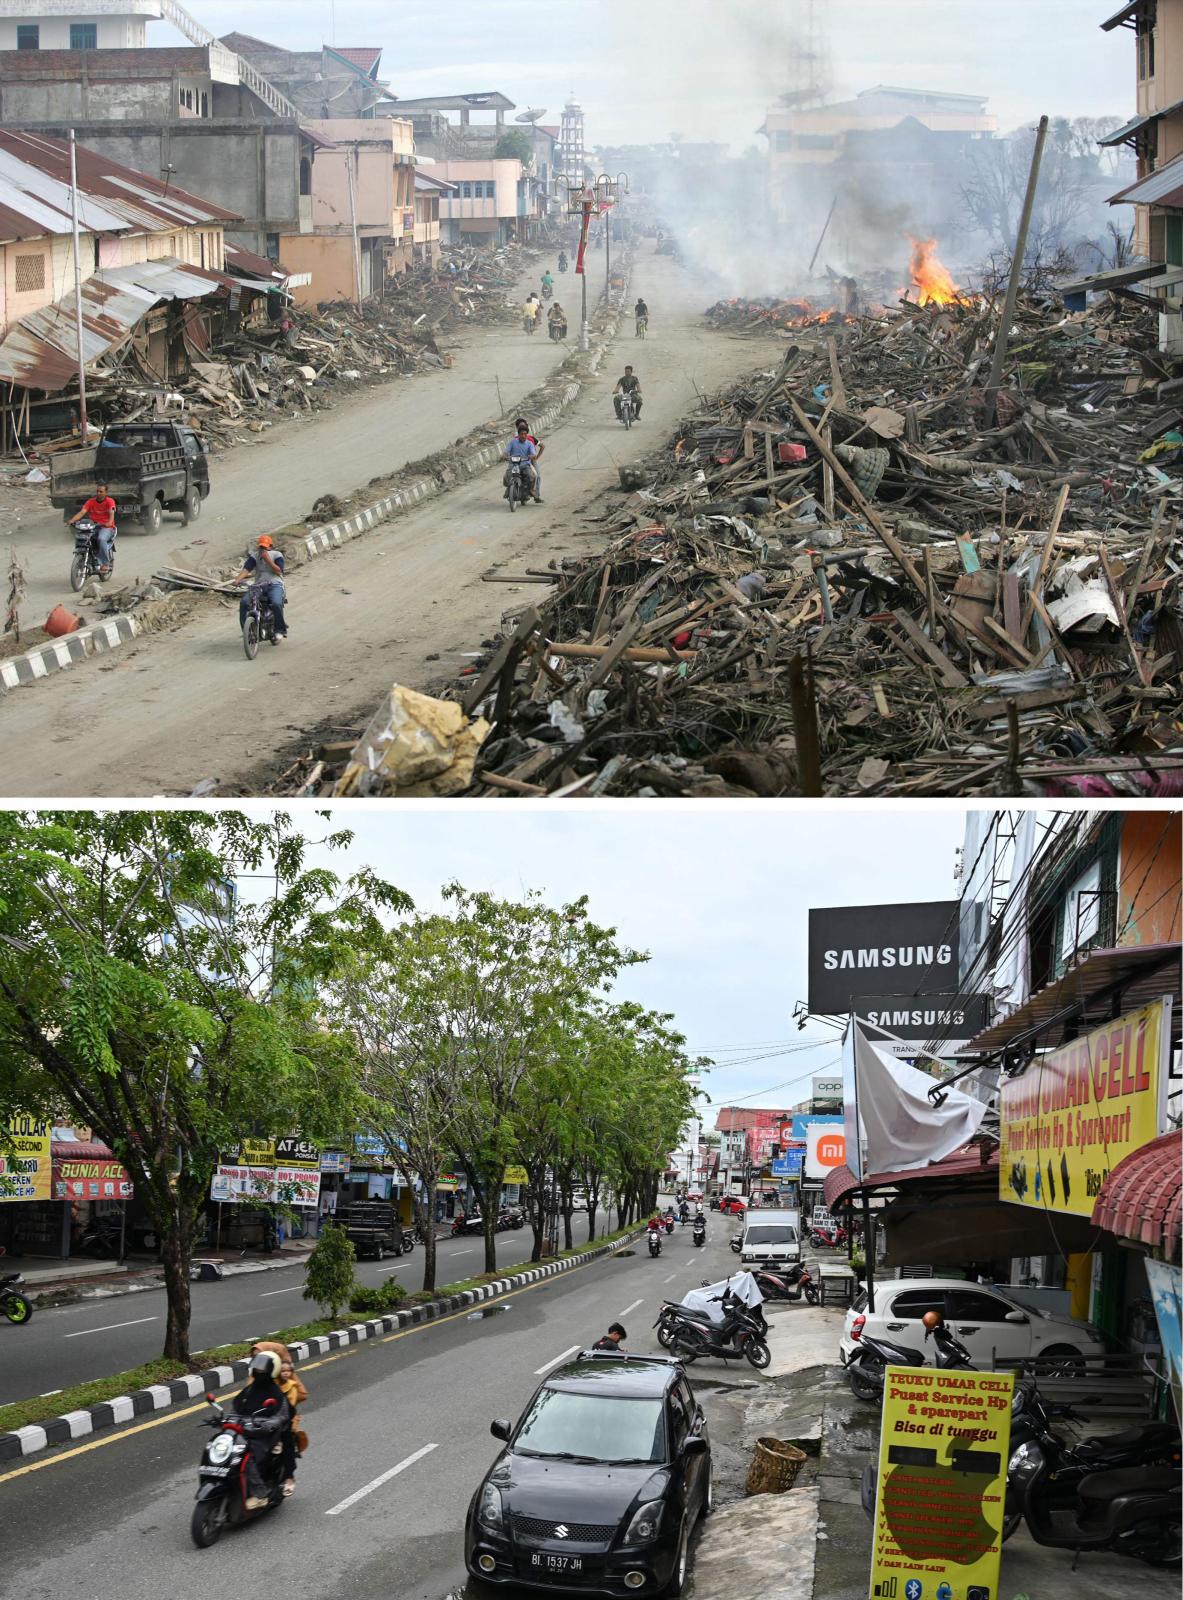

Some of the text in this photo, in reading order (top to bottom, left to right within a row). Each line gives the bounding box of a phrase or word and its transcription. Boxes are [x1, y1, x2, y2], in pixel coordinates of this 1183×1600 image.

[824, 944, 951, 970] SAMSUNG
[867, 1010, 965, 1026] SAMSUNG
[1094, 1019, 1150, 1102] CELL
[818, 1083, 843, 1092] opp
[1052, 1115, 1064, 1156] Hp
[1067, 1112, 1073, 1148] &
[1075, 1106, 1131, 1155] Sparepart
[101, 1165, 124, 1178] ACC
[278, 1172, 292, 1181] HOT
[294, 1173, 319, 1183] PROMO
[888, 1373, 1011, 1393] TEUKU UMAR CELL
[932, 1391, 984, 1406] Service
[987, 1395, 1008, 1411] Hp
[907, 1403, 988, 1421] & sparepart
[894, 1420, 998, 1442] Bisa di tunggu
[548, 1556, 568, 1568] 1537
[570, 1559, 582, 1570] JH
[884, 1560, 946, 1573] DAN LAIN LAIN
